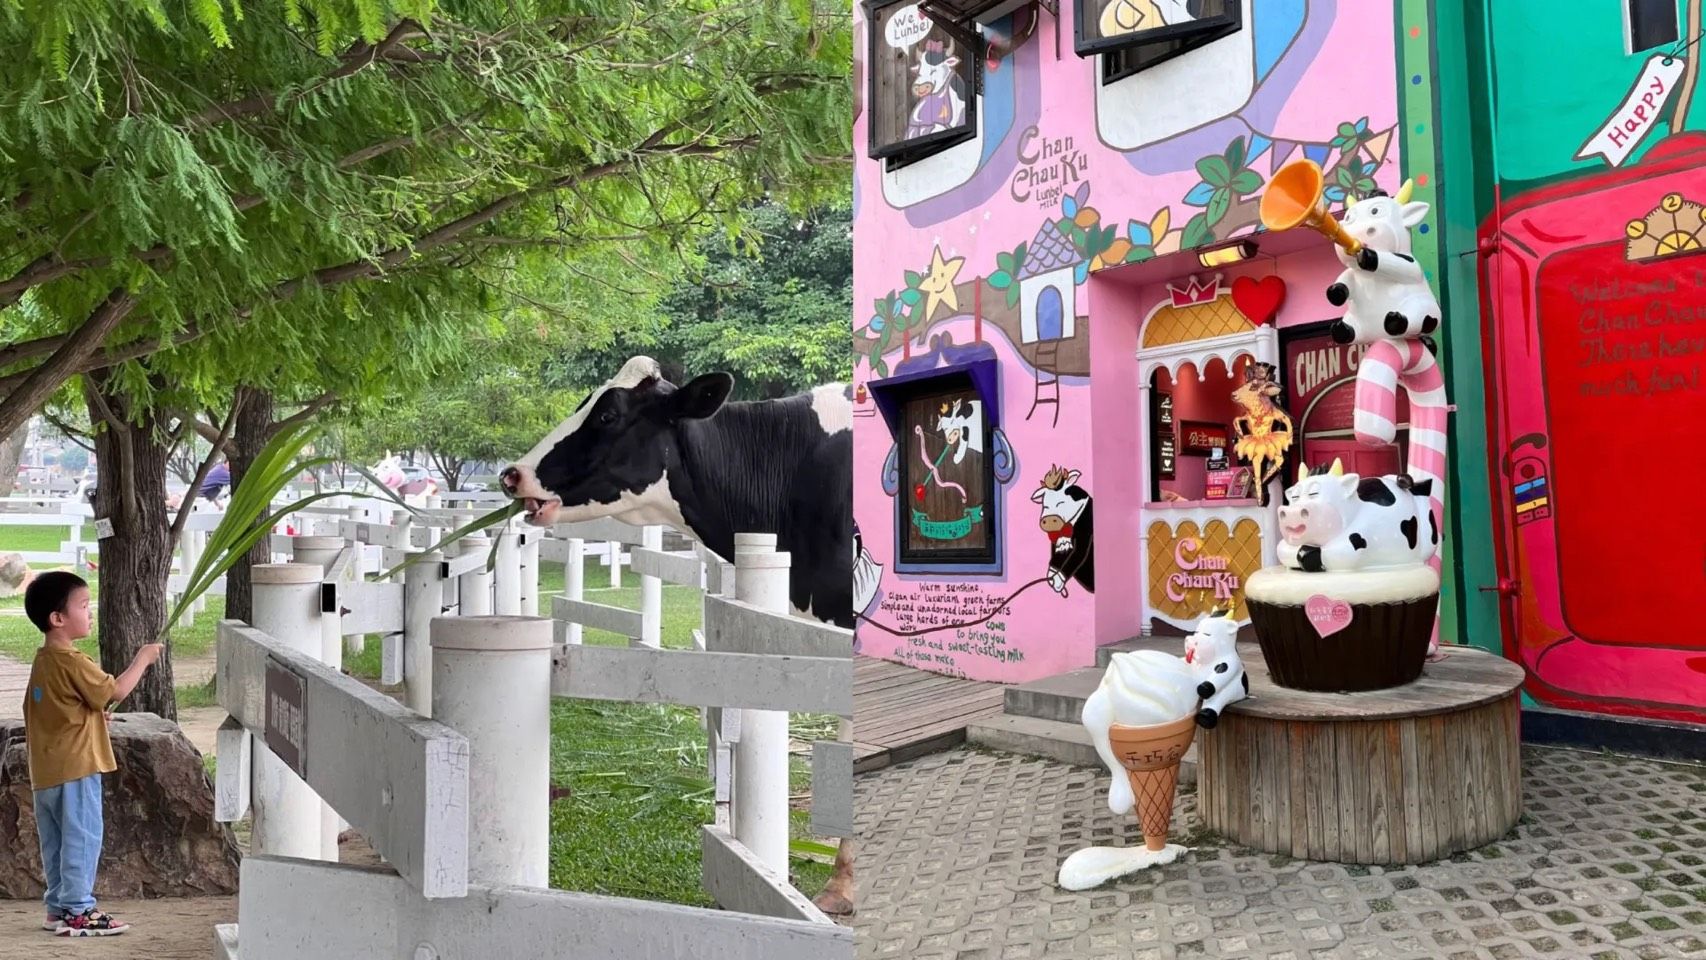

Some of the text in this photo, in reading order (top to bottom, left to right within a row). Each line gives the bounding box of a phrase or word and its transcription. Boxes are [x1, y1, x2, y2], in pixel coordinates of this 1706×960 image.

[894, 14, 914, 27] We
[1607, 76, 1665, 148] Happy
[1016, 124, 1074, 166] Chan
[1667, 196, 1677, 207] 2
[1568, 277, 1677, 304] Welcome
[1579, 307, 1641, 334] Chan
[1578, 332, 1706, 367] There hav
[1295, 347, 1340, 398] CHAN
[1579, 364, 1698, 398] much fun!
[1175, 537, 1226, 571] Chan
[910, 592, 920, 601] air
[919, 583, 940, 592] Warm
[917, 612, 938, 624] herds
[942, 616, 949, 626] of
[958, 607, 977, 616] local
[928, 641, 943, 650] and
[957, 629, 1006, 646] to bring you
